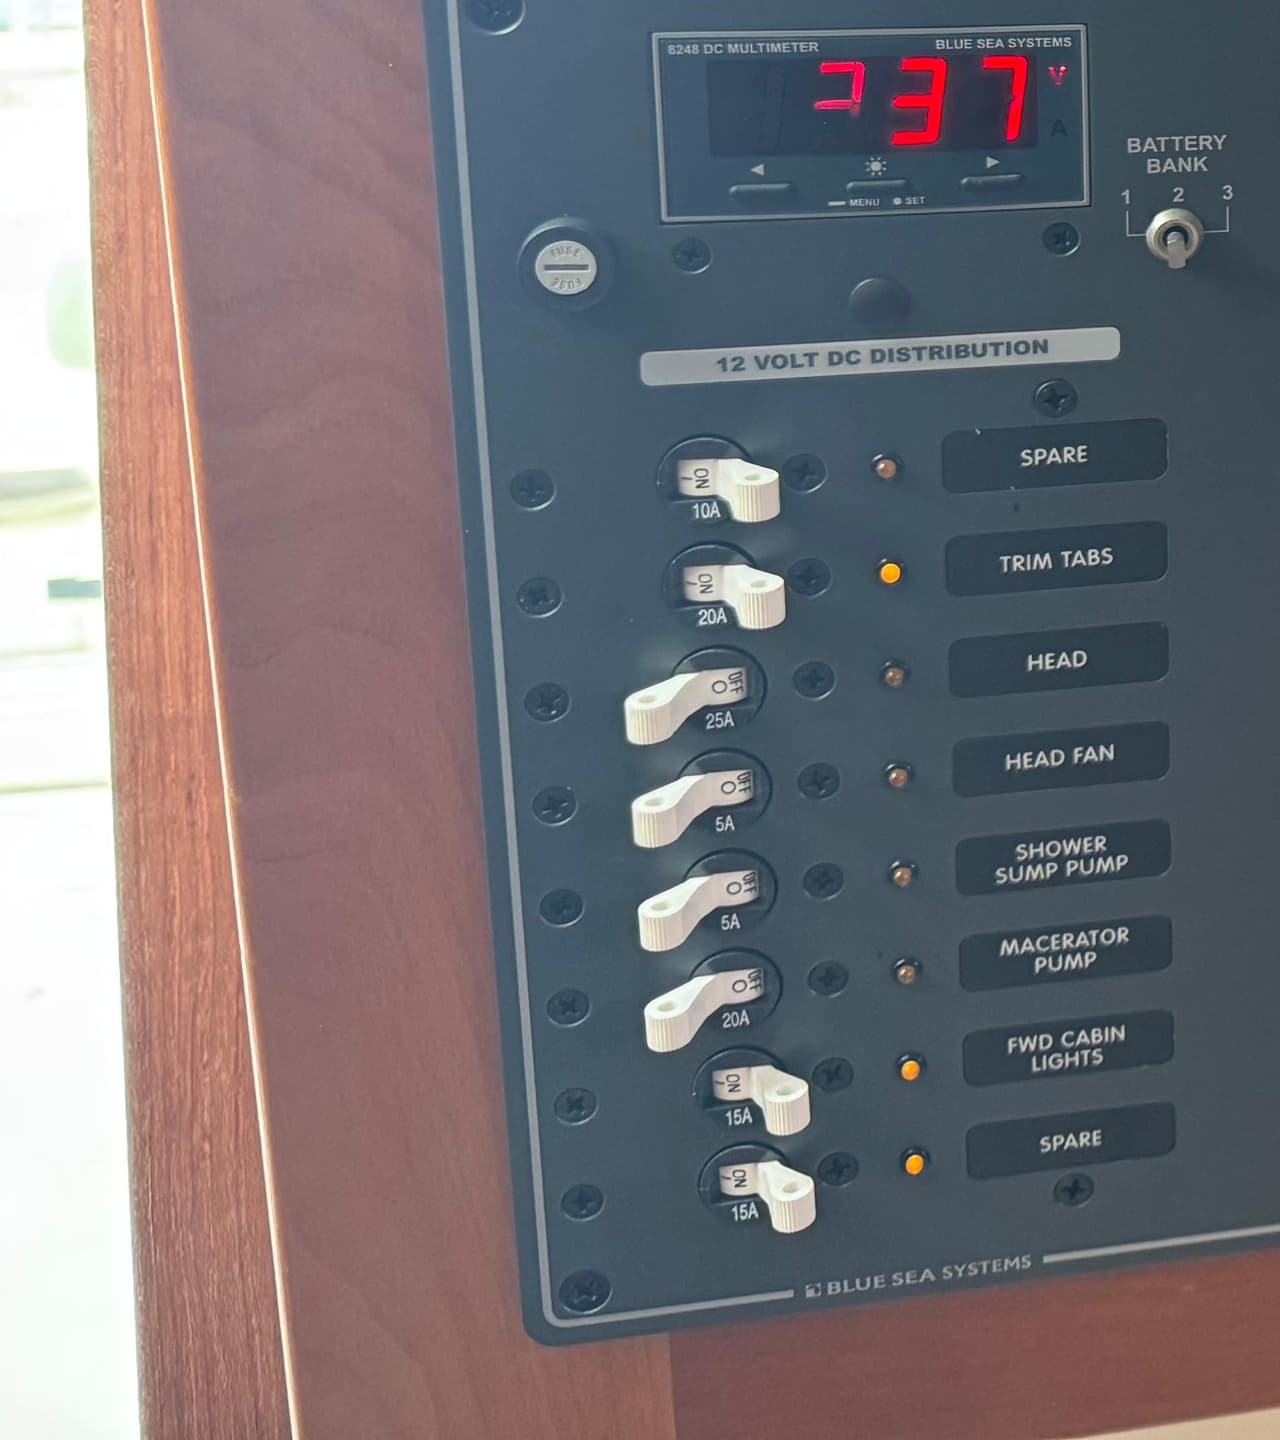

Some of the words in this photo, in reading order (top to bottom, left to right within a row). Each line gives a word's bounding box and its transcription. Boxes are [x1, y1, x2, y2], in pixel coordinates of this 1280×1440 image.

[668, 43, 699, 55] 8248
[703, 43, 724, 55] DC
[728, 40, 819, 55] MULTIMETER
[936, 38, 974, 50] BLUE
[978, 37, 1005, 49] SEA
[1008, 36, 1072, 49] SYSTEMS
[1126, 135, 1227, 153] BATTERY
[1146, 156, 1208, 174] BANK
[850, 197, 879, 207] MENU
[906, 196, 925, 205] SET
[1122, 189, 1131, 204] 1
[1173, 186, 1184, 202] 2
[1222, 185, 1233, 200] 3
[717, 355, 744, 373] 12
[754, 350, 819, 371] VOLT
[827, 349, 862, 367] DC
[869, 338, 1049, 365] DISTRIBUTION
[1021, 446, 1088, 467] SPARE
[692, 502, 721, 519] 10A
[1000, 553, 1053, 574] TRIM
[1061, 547, 1113, 568] TABS
[1028, 651, 1088, 671] HEAD
[706, 712, 734, 729] 25A
[1005, 750, 1065, 771] HEAD
[1073, 744, 1115, 764] FAN
[1016, 835, 1107, 860] SHOWER
[995, 862, 1058, 885] SUMP
[1066, 855, 1129, 878] PUMP
[1000, 927, 1129, 958] MACERATOR
[1034, 951, 1097, 974] PUMP
[1008, 1033, 1053, 1055] FWD
[1060, 1025, 1126, 1049] CABIN
[1031, 1049, 1104, 1072] LIGHTS
[1039, 1130, 1102, 1153] SPARE
[827, 1274, 886, 1295] BLUE
[891, 1268, 937, 1287] SEA
[942, 1255, 1032, 1280] SYSTEMS
